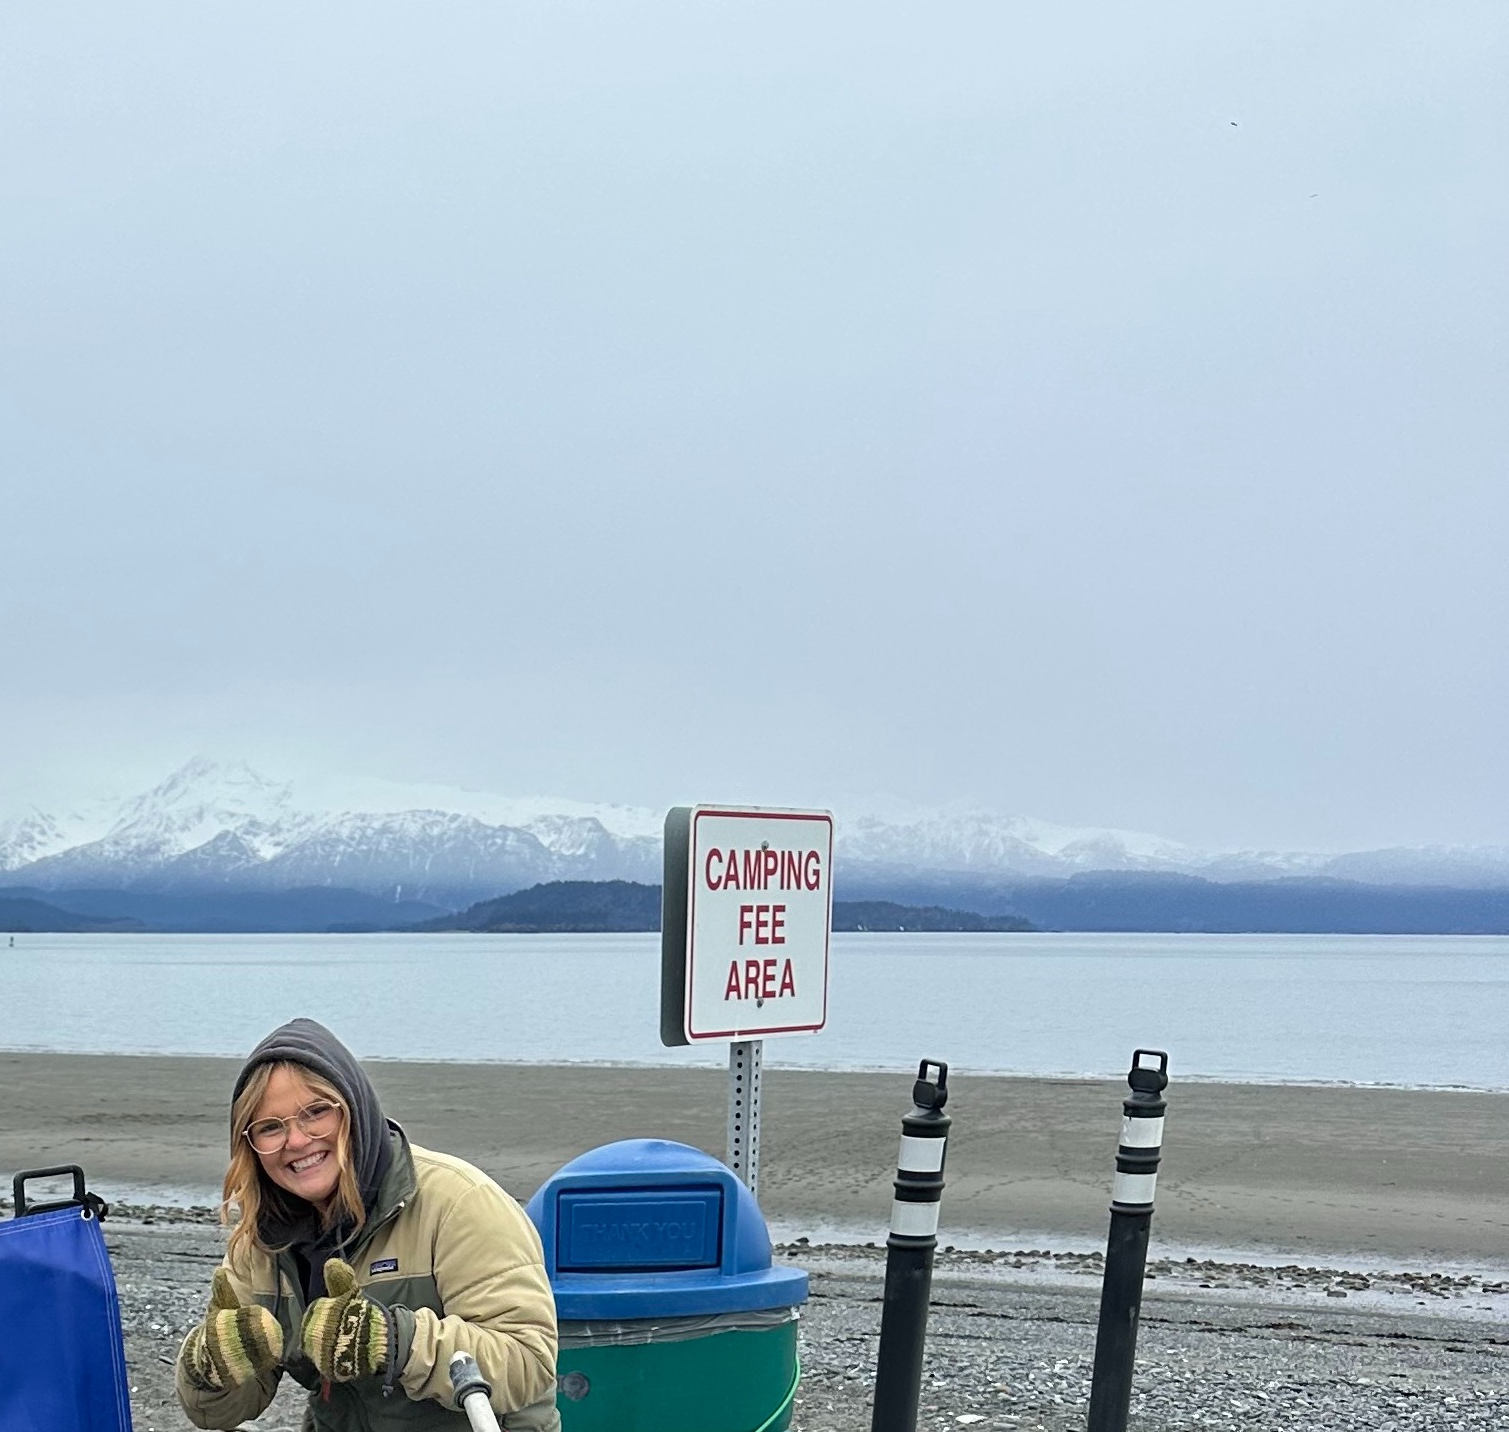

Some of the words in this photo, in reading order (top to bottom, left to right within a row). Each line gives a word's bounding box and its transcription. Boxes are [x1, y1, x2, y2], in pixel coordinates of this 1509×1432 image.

[705, 848, 820, 890] CAMPING
[739, 904, 786, 945] FEE
[724, 958, 796, 1001] AREA
[580, 1222, 650, 1242] THANK
[653, 1221, 696, 1240] YOU
